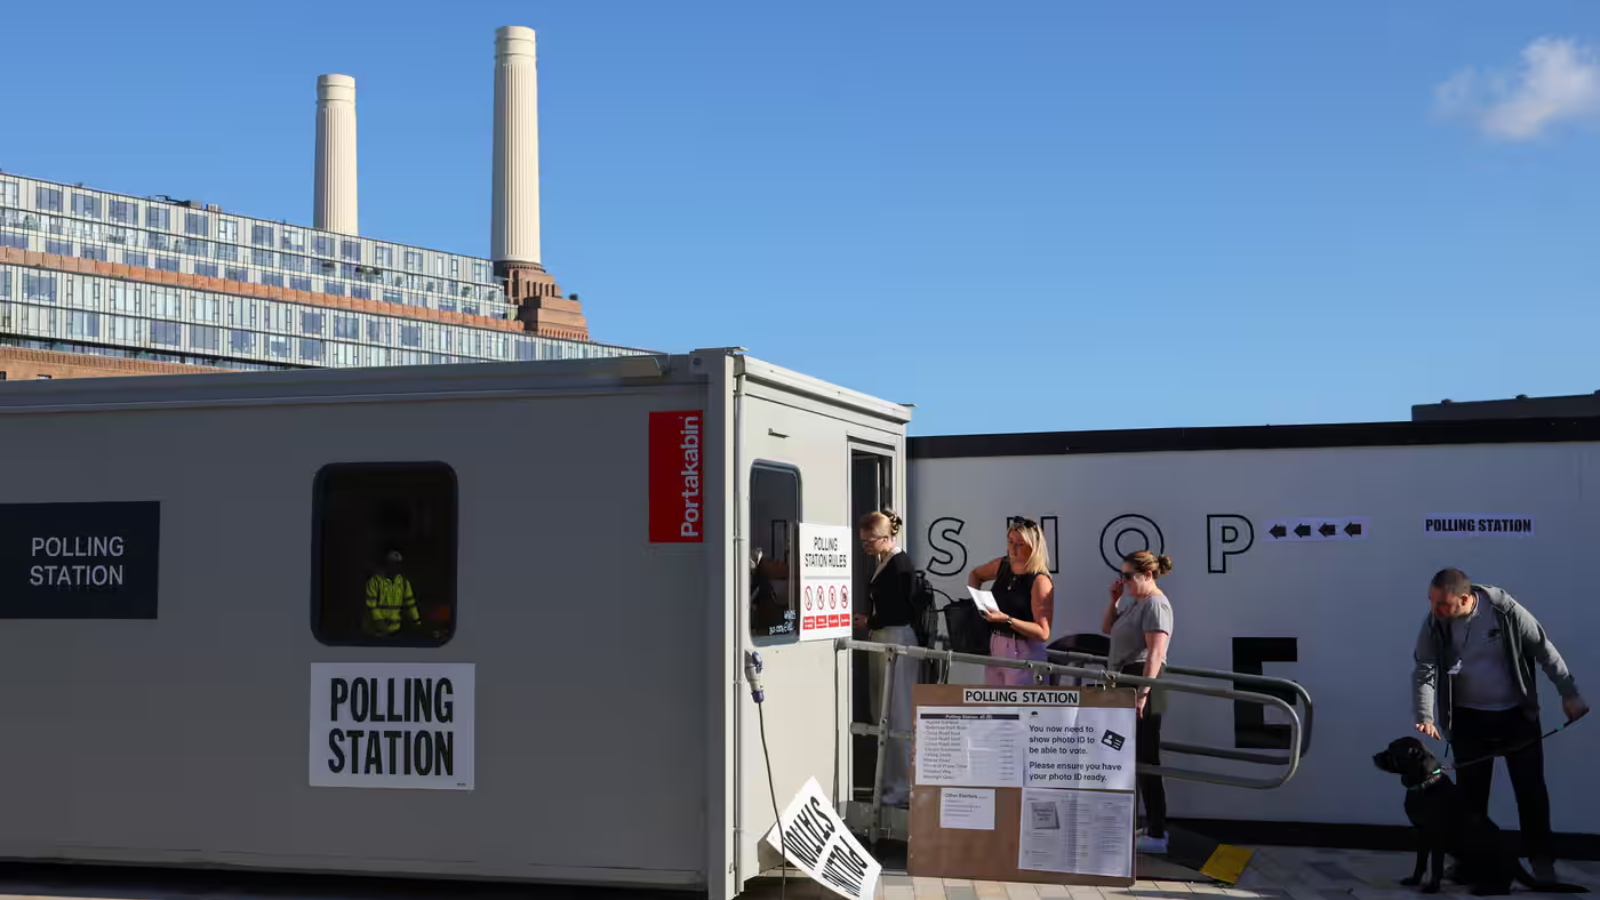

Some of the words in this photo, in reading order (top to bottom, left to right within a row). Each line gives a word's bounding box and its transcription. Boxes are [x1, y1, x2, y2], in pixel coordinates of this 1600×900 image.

[680, 416, 699, 537] Portakabin
[1425, 519, 1475, 532] POLLING
[1478, 519, 1532, 533] STATION
[31, 536, 124, 557] POLLING
[813, 536, 838, 552] POLLING
[805, 553, 828, 568] STATION
[828, 553, 847, 568] RULES
[29, 565, 124, 586] STATION
[331, 677, 454, 723] POLLING
[965, 690, 1017, 702] POLLING
[1022, 691, 1078, 703] STATION
[1029, 725, 1044, 733] You
[1064, 725, 1084, 733] need
[1052, 736, 1075, 746] photo
[328, 728, 454, 776] STATION
[1029, 761, 1055, 769] Please
[1085, 764, 1100, 772] you
[1102, 763, 1122, 771] have
[1029, 773, 1047, 781] your
[1048, 773, 1072, 781] photo
[1083, 773, 1107, 782] ready.
[783, 796, 836, 871] STATION
